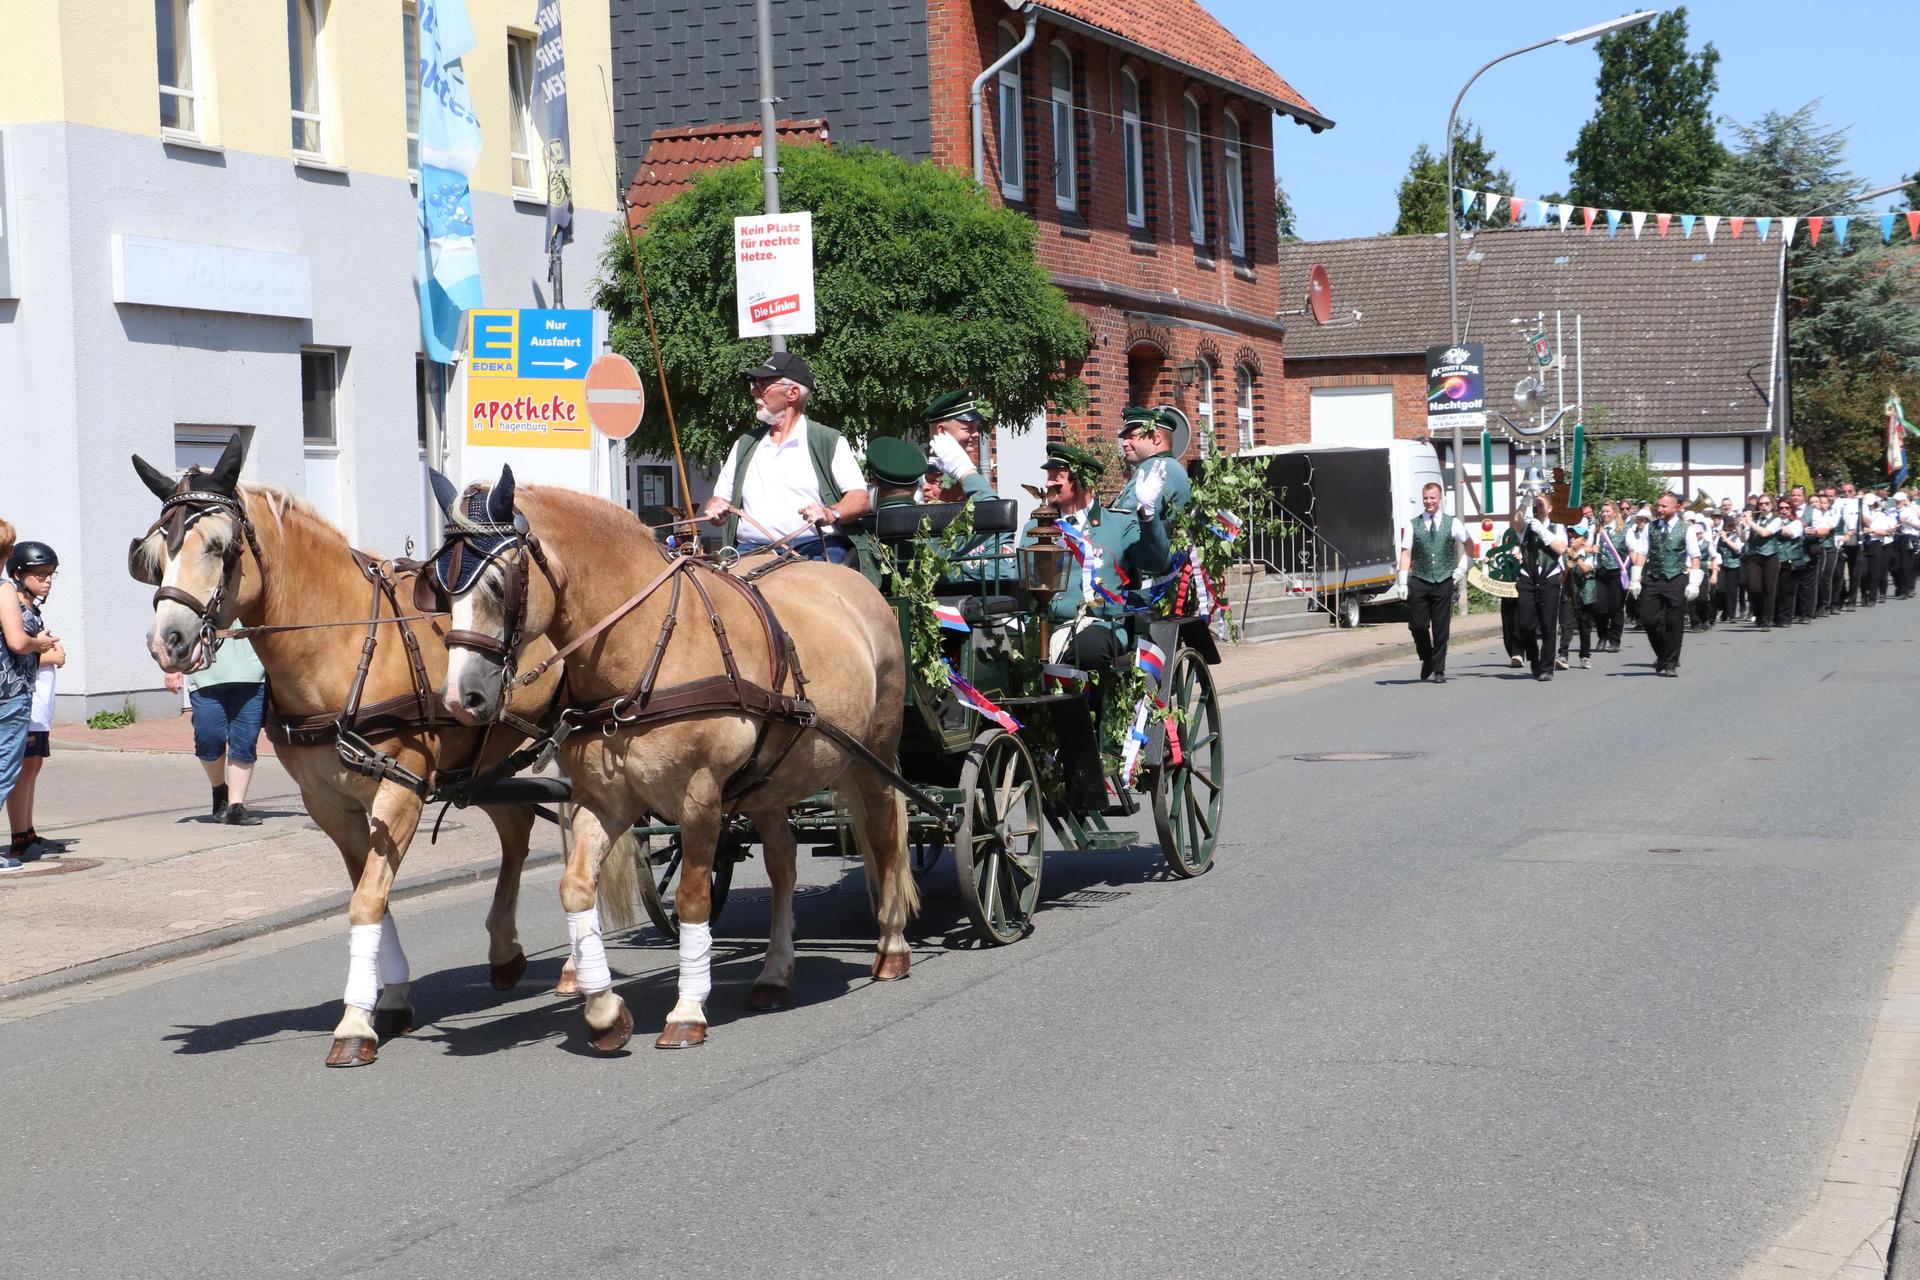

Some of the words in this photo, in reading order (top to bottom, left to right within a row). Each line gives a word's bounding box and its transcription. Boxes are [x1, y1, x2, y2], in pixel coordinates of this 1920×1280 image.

[741, 224, 764, 236] Kein
[767, 223, 801, 234] Platz
[740, 238, 757, 249] für
[759, 236, 801, 248] rechte
[741, 251, 777, 262] Hetze.
[754, 307, 769, 319] Die
[769, 300, 797, 314] Linke
[545, 319, 567, 330] Nur
[473, 315, 513, 359] E
[530, 336, 582, 347] Ausfahrt
[472, 362, 513, 371] EDEKA
[1429, 399, 1483, 411] Nachtgolf
[473, 395, 576, 428] apotheke
[474, 421, 483, 429] in
[499, 421, 547, 432] hagenburg
